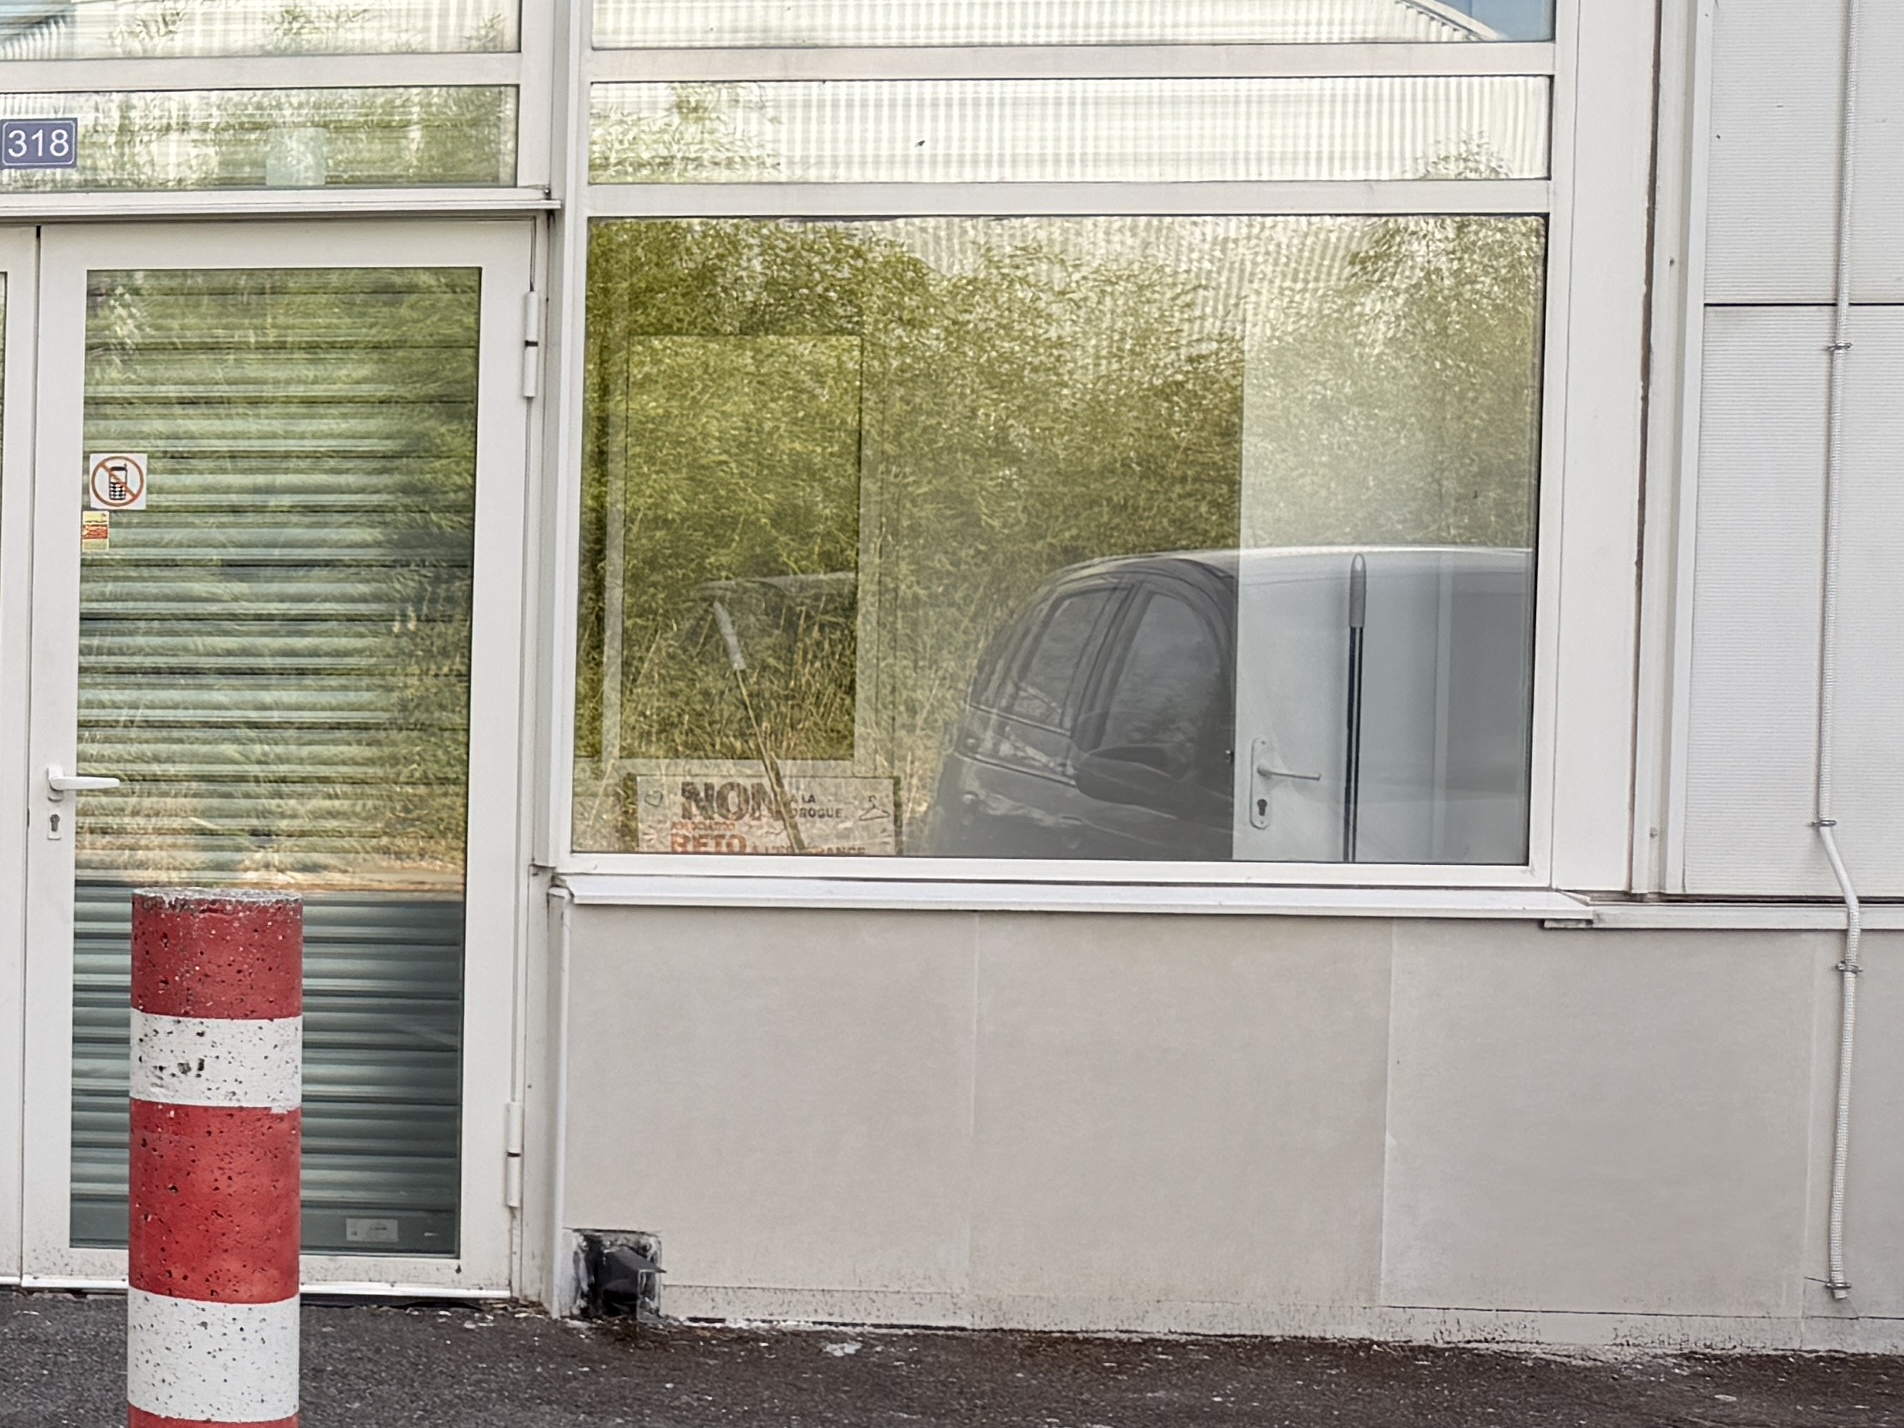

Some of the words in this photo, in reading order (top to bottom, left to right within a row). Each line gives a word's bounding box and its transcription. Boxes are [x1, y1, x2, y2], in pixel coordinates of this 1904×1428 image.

[8, 128, 69, 157] 318
[681, 782, 784, 821] NON
[801, 794, 817, 804] LA
[789, 807, 844, 819] DROGUE
[671, 833, 748, 854] RETO
